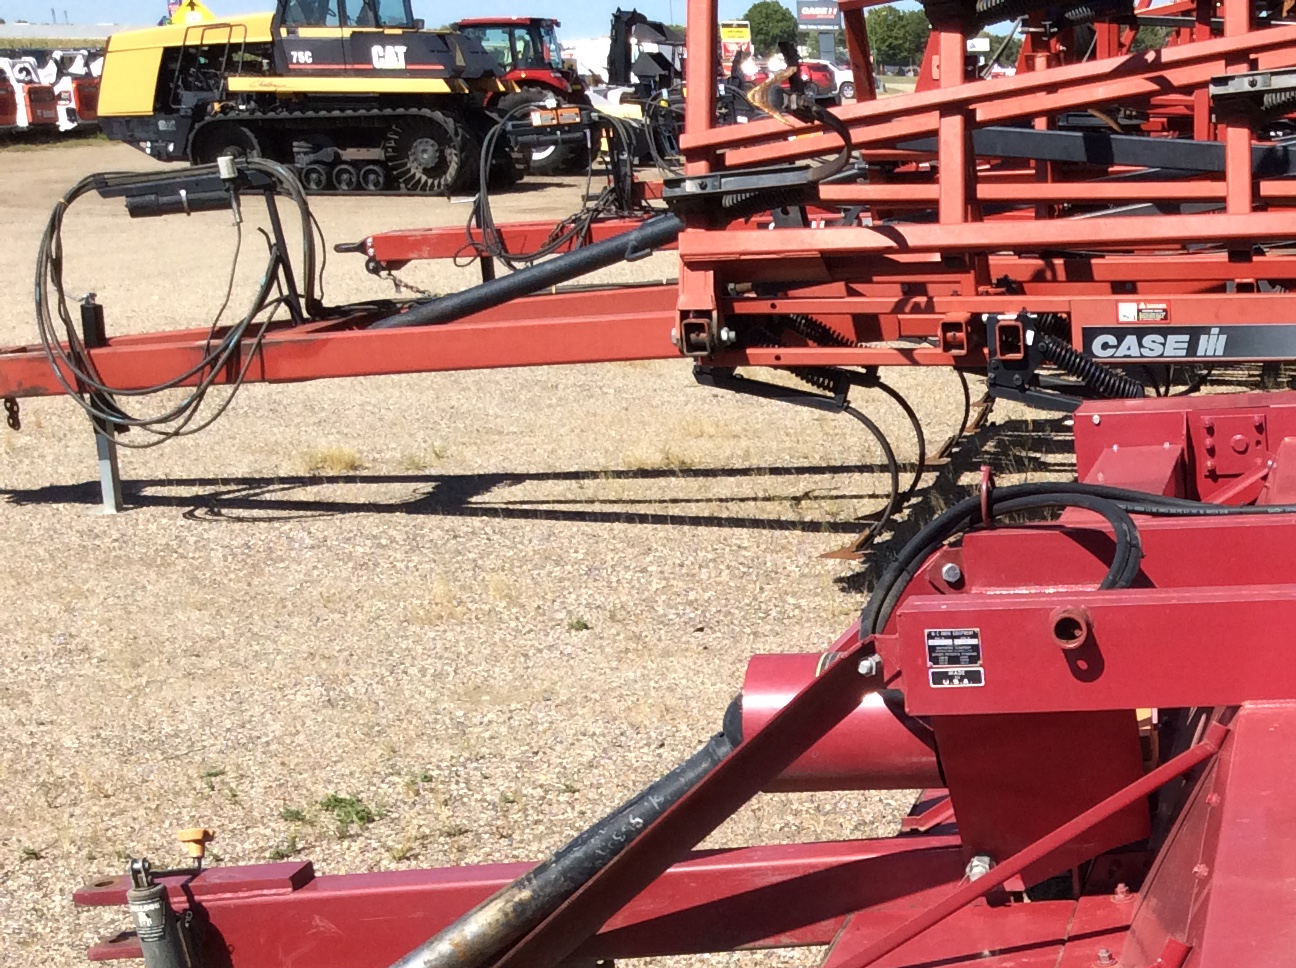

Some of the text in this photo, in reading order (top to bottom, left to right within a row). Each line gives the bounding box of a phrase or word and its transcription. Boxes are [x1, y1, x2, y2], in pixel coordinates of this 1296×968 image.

[290, 45, 407, 70] 75C CAT
[1091, 334, 1190, 357] CASE
